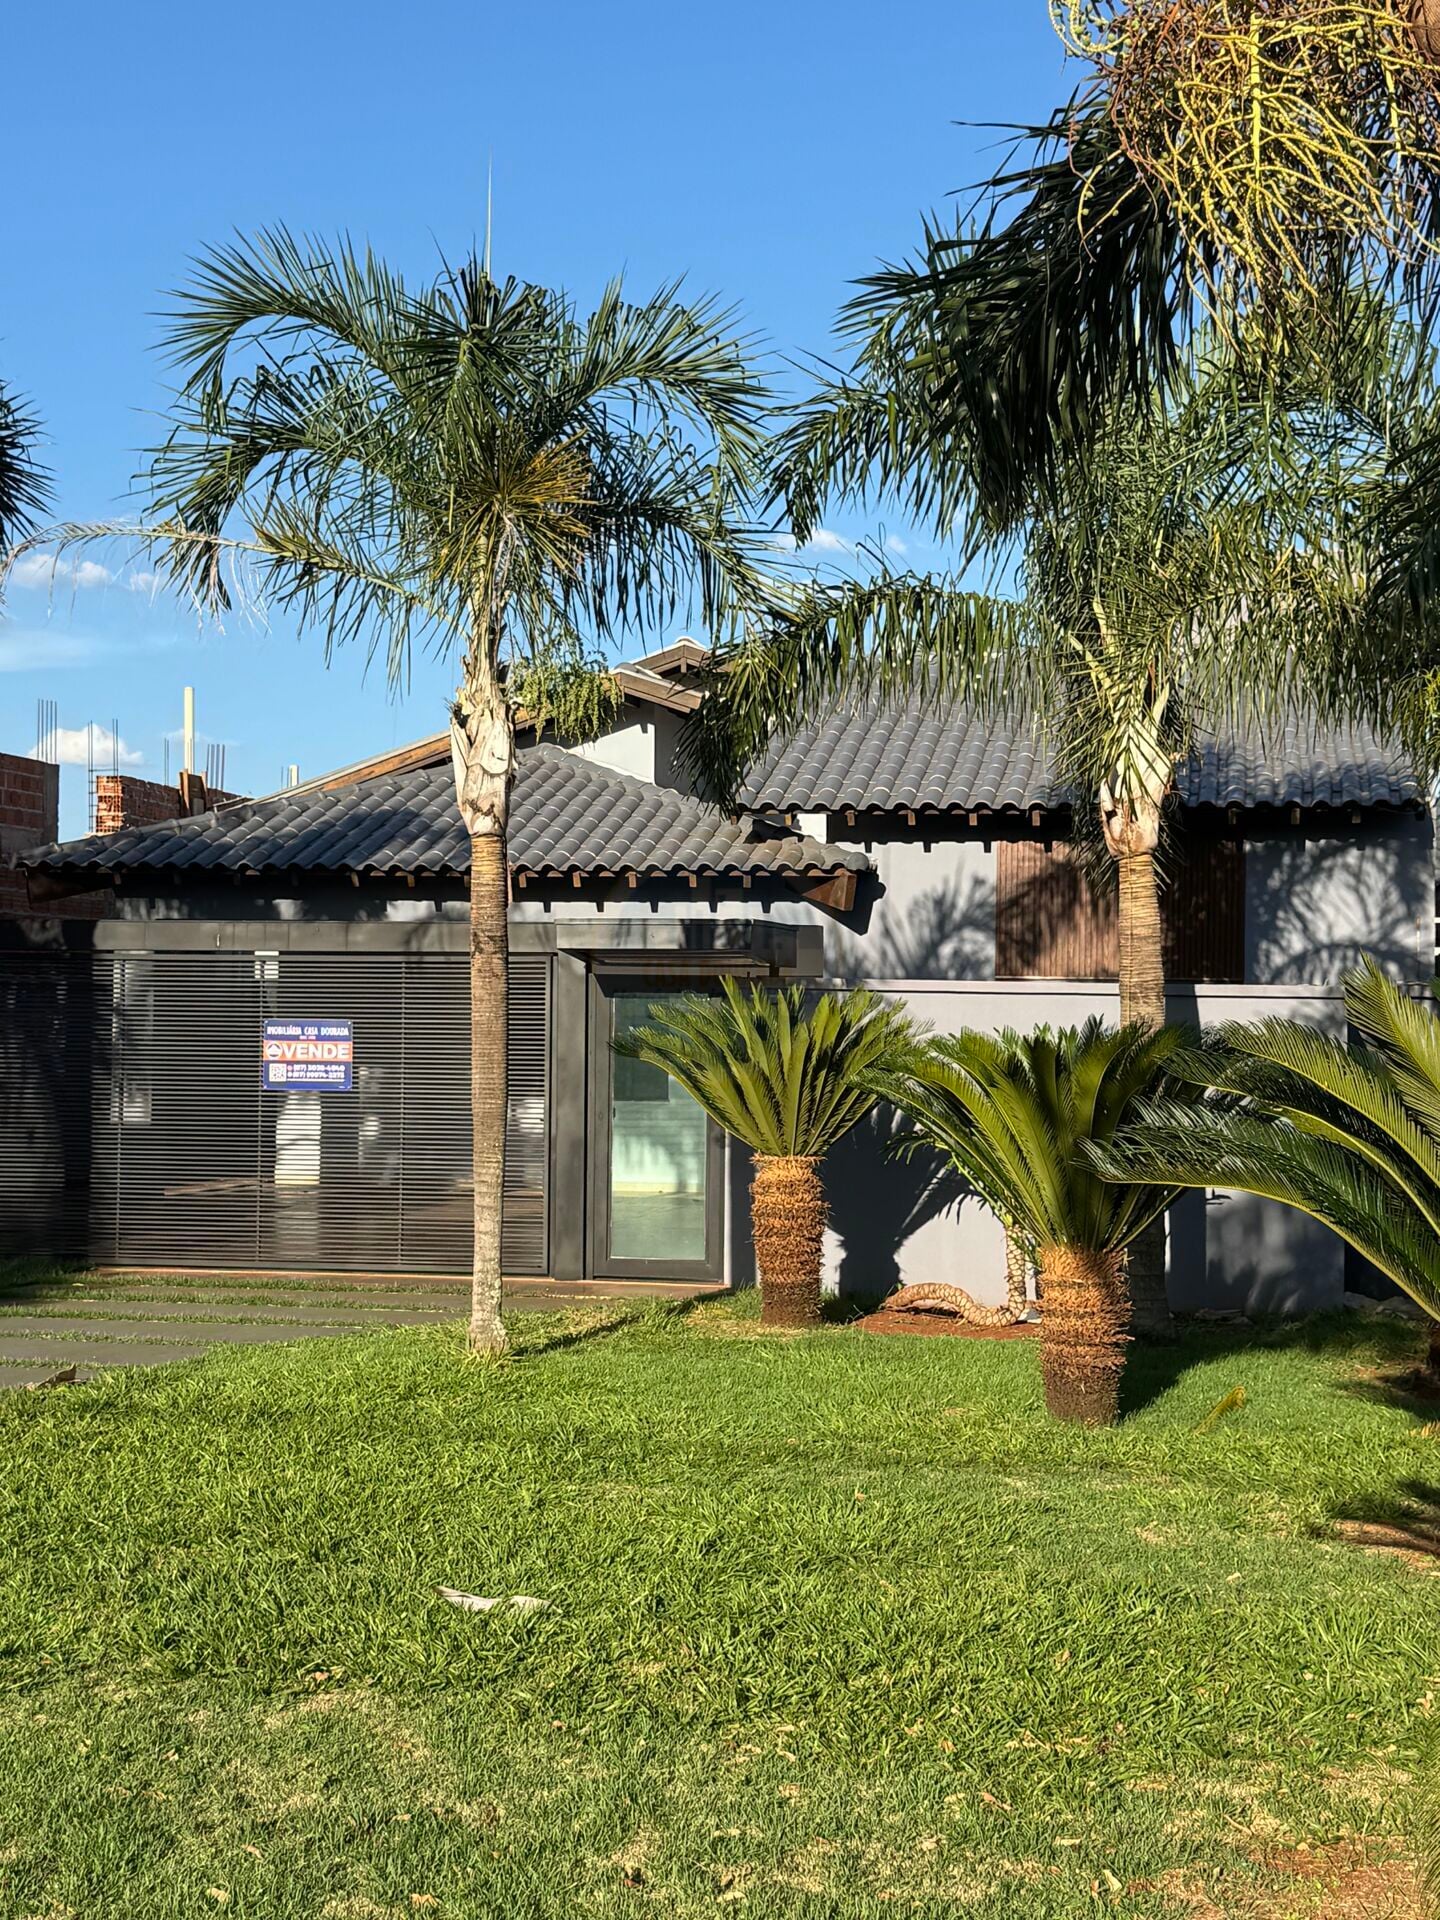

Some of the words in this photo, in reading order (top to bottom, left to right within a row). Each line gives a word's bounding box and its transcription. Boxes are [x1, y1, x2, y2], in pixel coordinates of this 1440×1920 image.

[304, 1026, 318, 1035] CASA
[320, 1027, 349, 1036] DOURADA
[281, 1043, 350, 1059] VENDE
